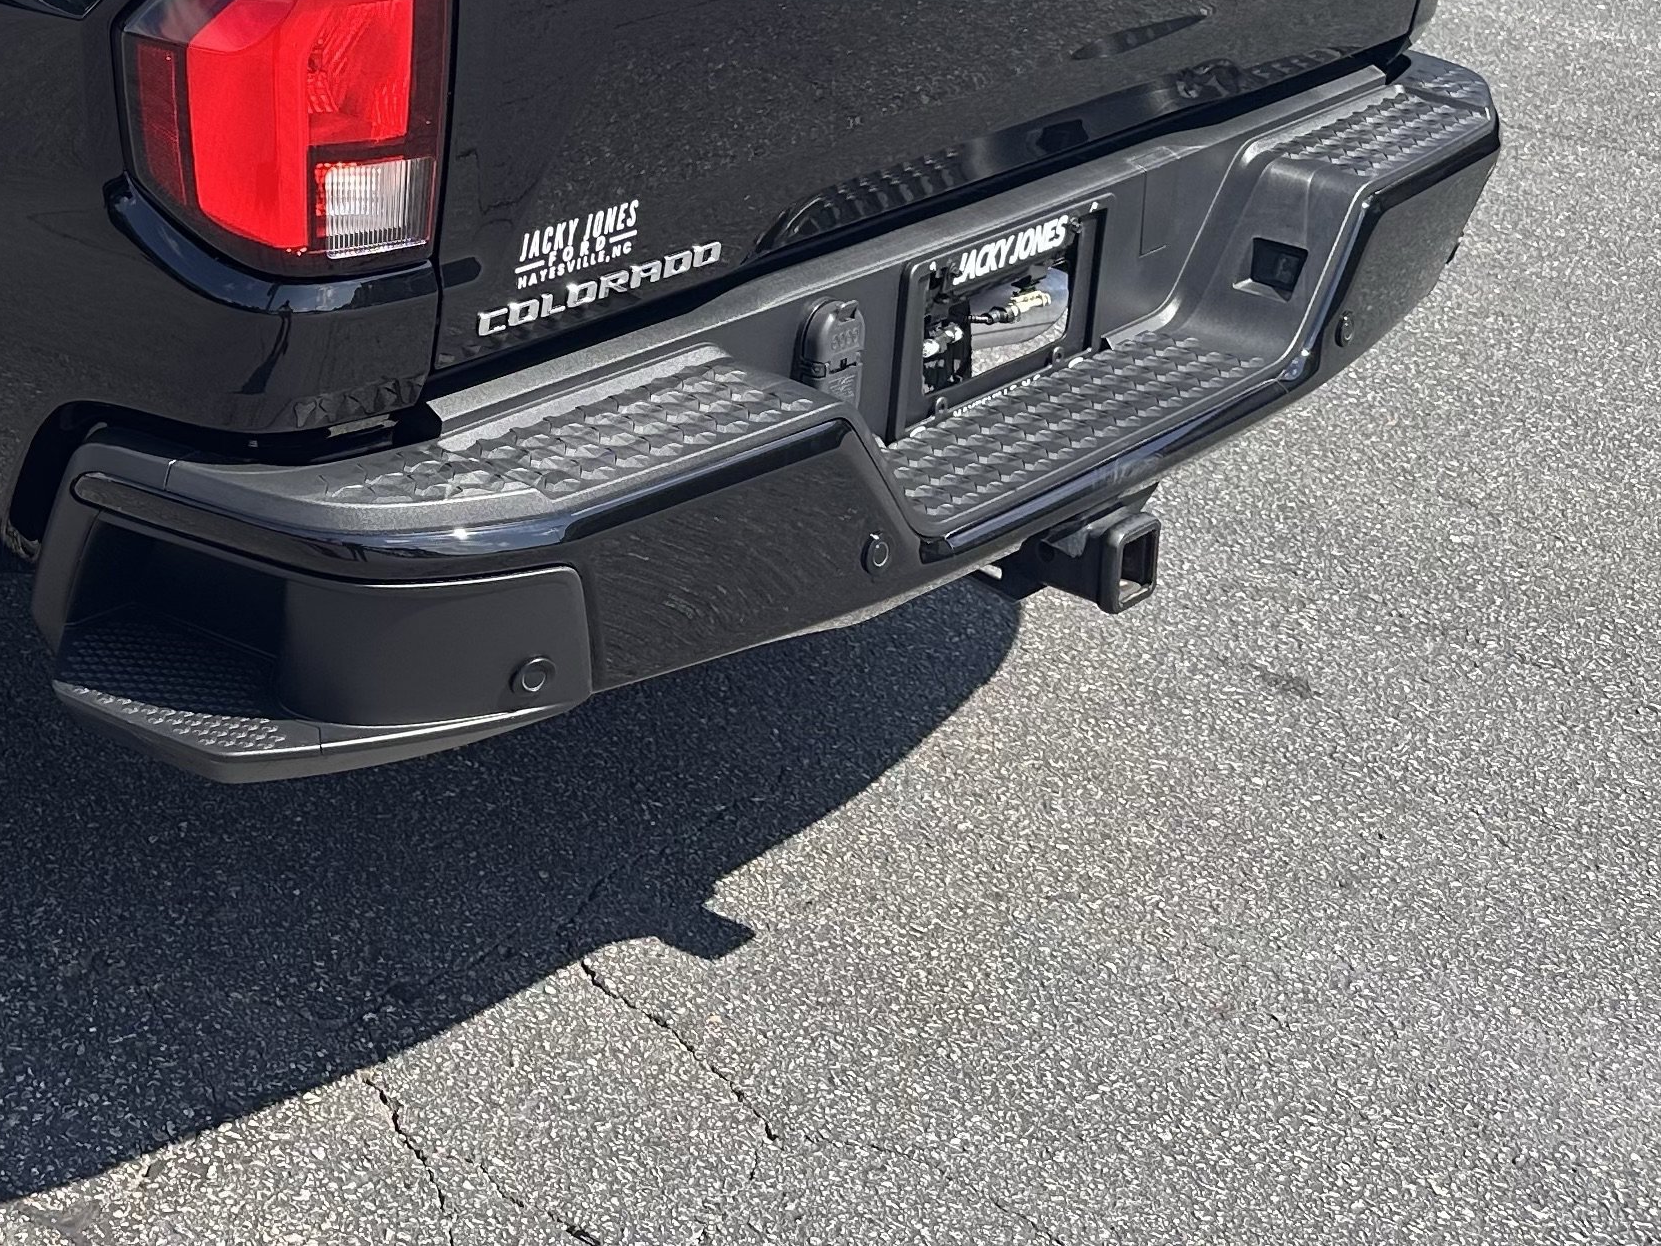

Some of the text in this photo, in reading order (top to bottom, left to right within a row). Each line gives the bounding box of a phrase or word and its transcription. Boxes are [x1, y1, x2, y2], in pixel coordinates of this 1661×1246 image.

[519, 199, 639, 262] JACKY JONES
[548, 235, 607, 267] FORD
[611, 241, 633, 260] NC
[952, 215, 1069, 285] JACKY JONES
[477, 241, 722, 337] COLORADO
